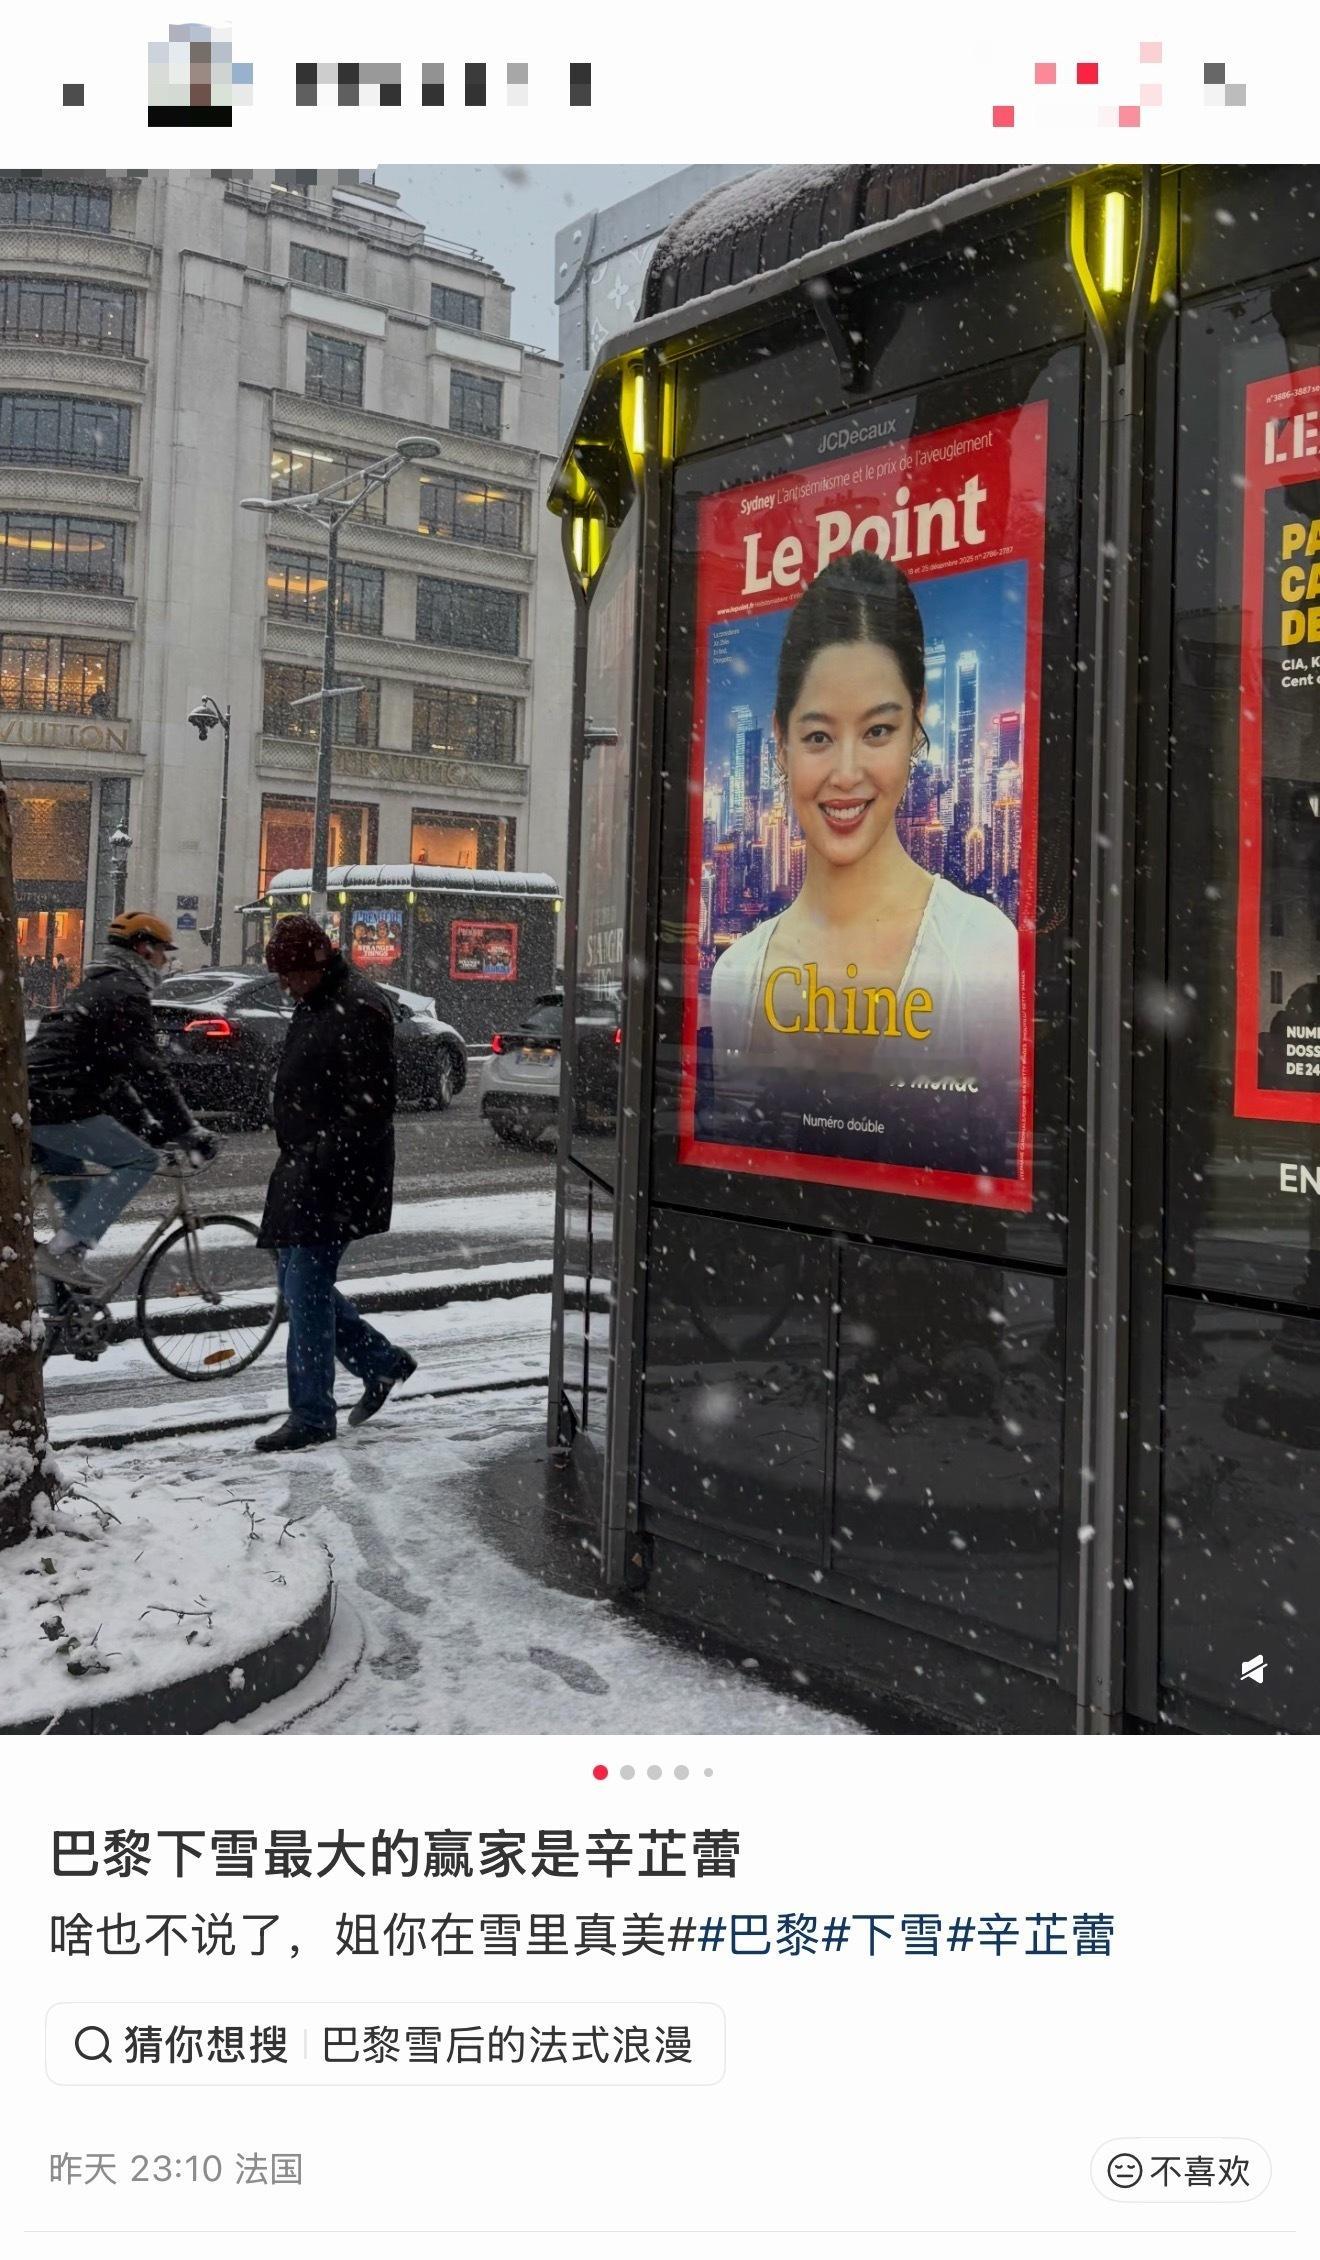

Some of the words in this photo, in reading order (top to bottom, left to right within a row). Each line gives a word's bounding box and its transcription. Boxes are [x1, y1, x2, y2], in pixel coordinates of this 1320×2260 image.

[818, 417, 897, 454] JCDecaux
[1264, 411, 1320, 465] L'E
[740, 493, 776, 515] Sydney
[777, 474, 850, 504] L'antisémitisme
[853, 468, 864, 482] et
[865, 464, 875, 480] le
[876, 459, 897, 481] prix
[899, 454, 913, 471] de
[915, 432, 993, 468] l'aveuglement
[741, 532, 803, 596] Le
[814, 474, 988, 579] Point
[959, 555, 974, 565] 2025
[1281, 607, 1320, 646] DE
[1281, 658, 1308, 672] CIA,
[1281, 674, 1314, 688] Cent
[763, 962, 934, 1040] Chine
[1286, 1043, 1320, 1058] DOSS
[1286, 1062, 1304, 1075] DE
[802, 1113, 845, 1131] Numéro
[847, 1117, 885, 1134] double
[1280, 1162, 1320, 1195] EN
